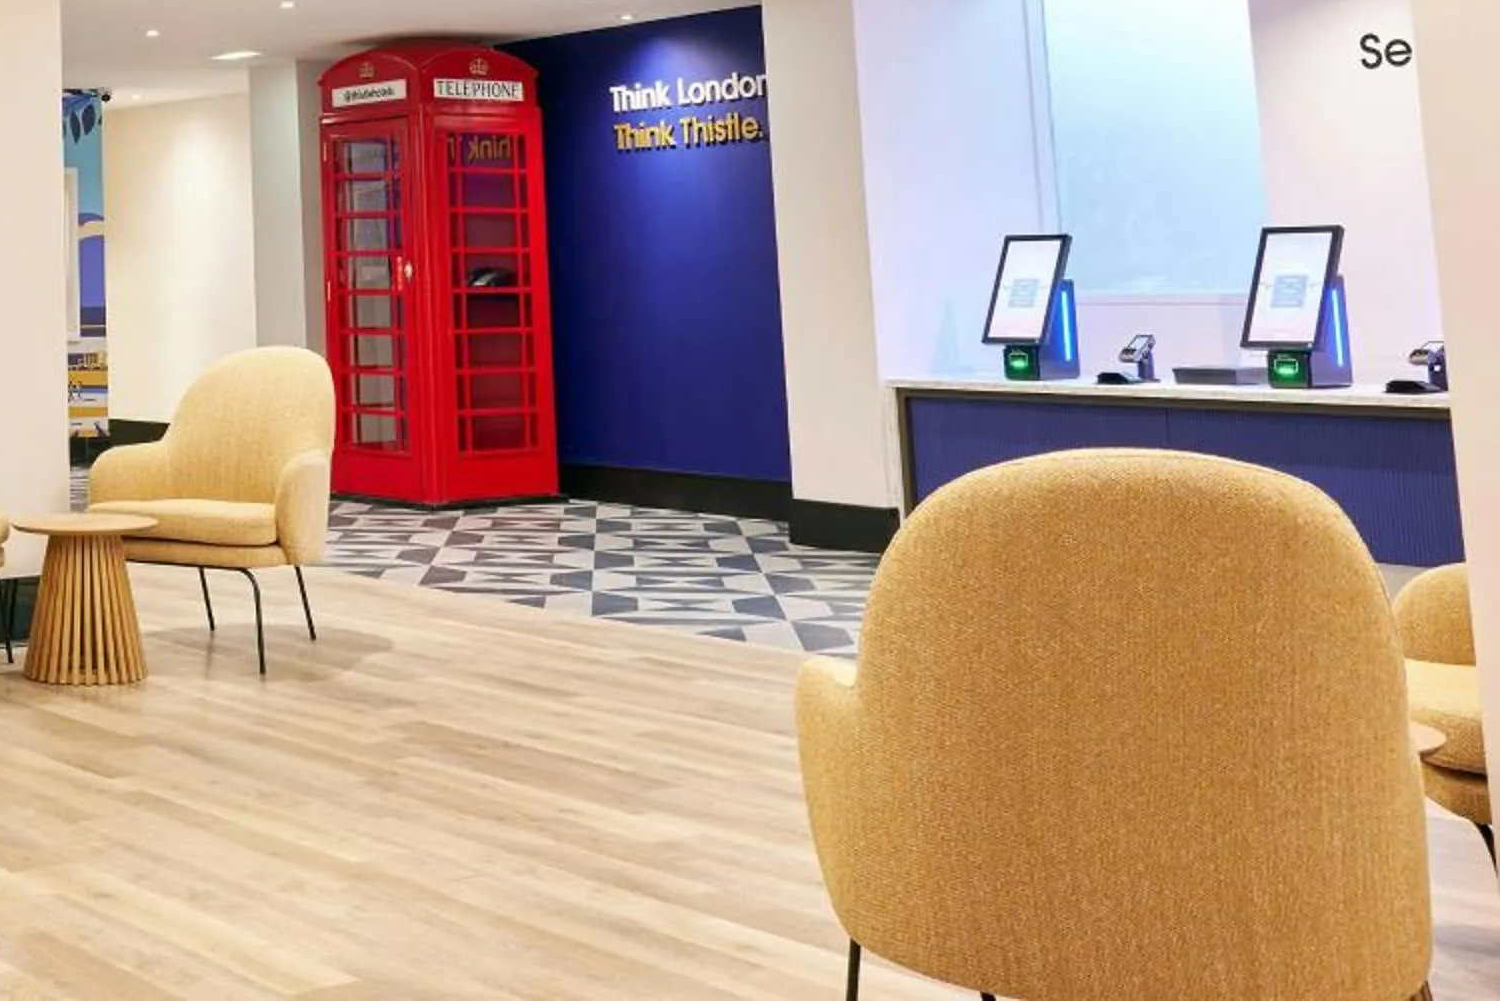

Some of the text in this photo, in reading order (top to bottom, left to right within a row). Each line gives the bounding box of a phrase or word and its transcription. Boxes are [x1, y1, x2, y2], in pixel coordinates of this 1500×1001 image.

[1359, 33, 1413, 70] Se
[436, 80, 519, 98] TELEPHONE
[609, 72, 768, 112] Think London
[614, 111, 764, 150] Think Thistle.
